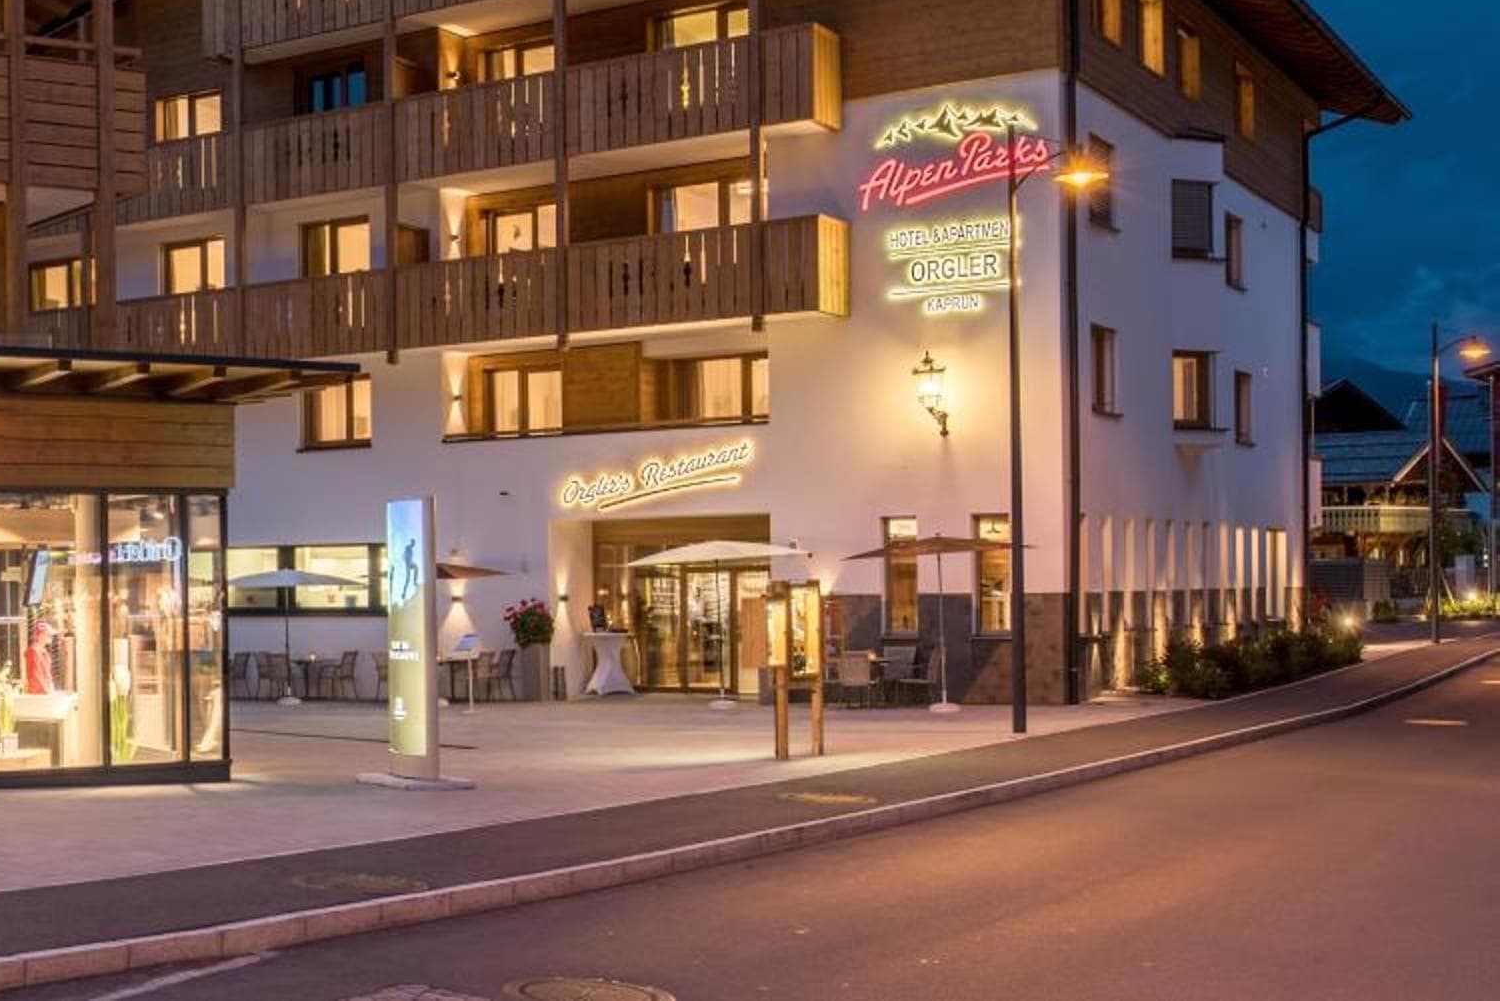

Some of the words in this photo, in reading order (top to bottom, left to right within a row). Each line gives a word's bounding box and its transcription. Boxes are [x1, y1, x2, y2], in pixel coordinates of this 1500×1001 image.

[860, 158, 957, 211] Alpen
[960, 132, 1050, 176] Parks
[890, 229, 930, 248] HOTEL
[910, 254, 998, 282] ORGLER
[927, 294, 980, 312] KAPRUN
[563, 473, 632, 504] Orgler's
[642, 442, 750, 487] Restaurant
